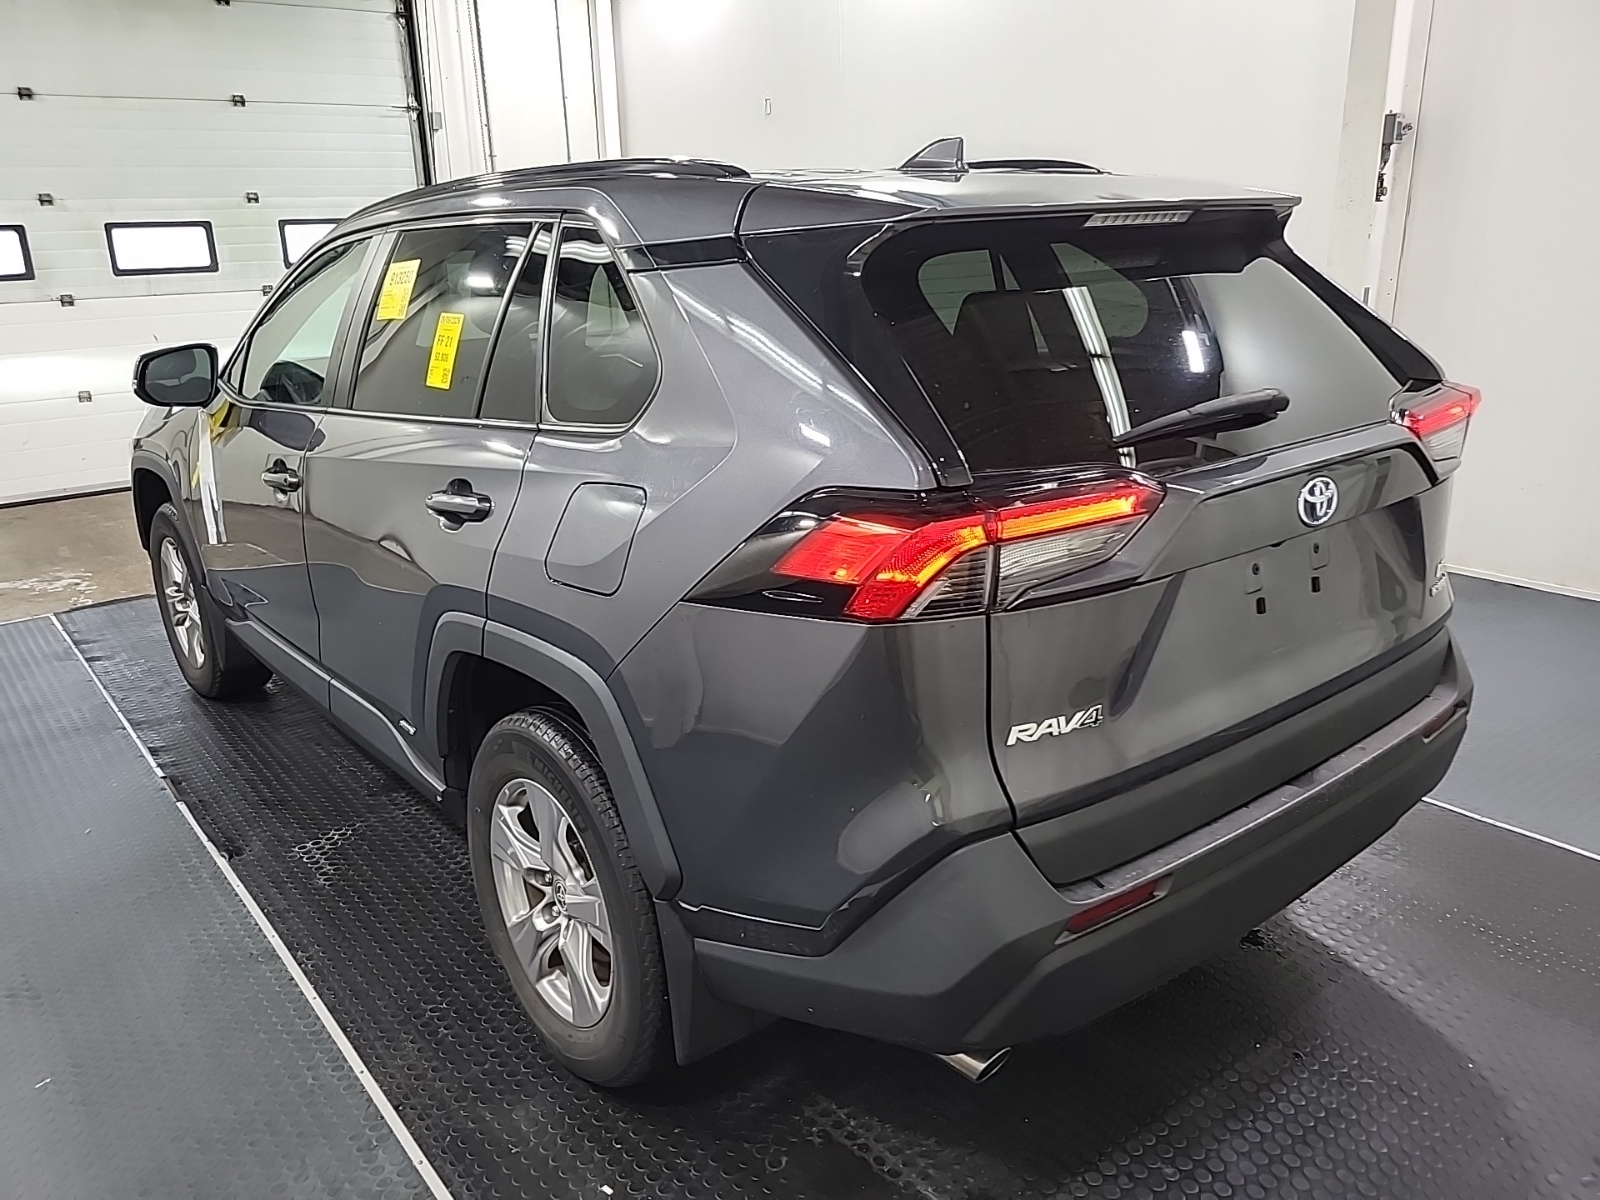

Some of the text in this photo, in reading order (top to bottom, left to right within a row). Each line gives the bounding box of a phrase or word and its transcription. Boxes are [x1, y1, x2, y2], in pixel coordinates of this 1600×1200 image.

[437, 334, 453, 347] FF 21
[1006, 704, 1104, 746] RAV4
[531, 757, 586, 834] MICHELIN
